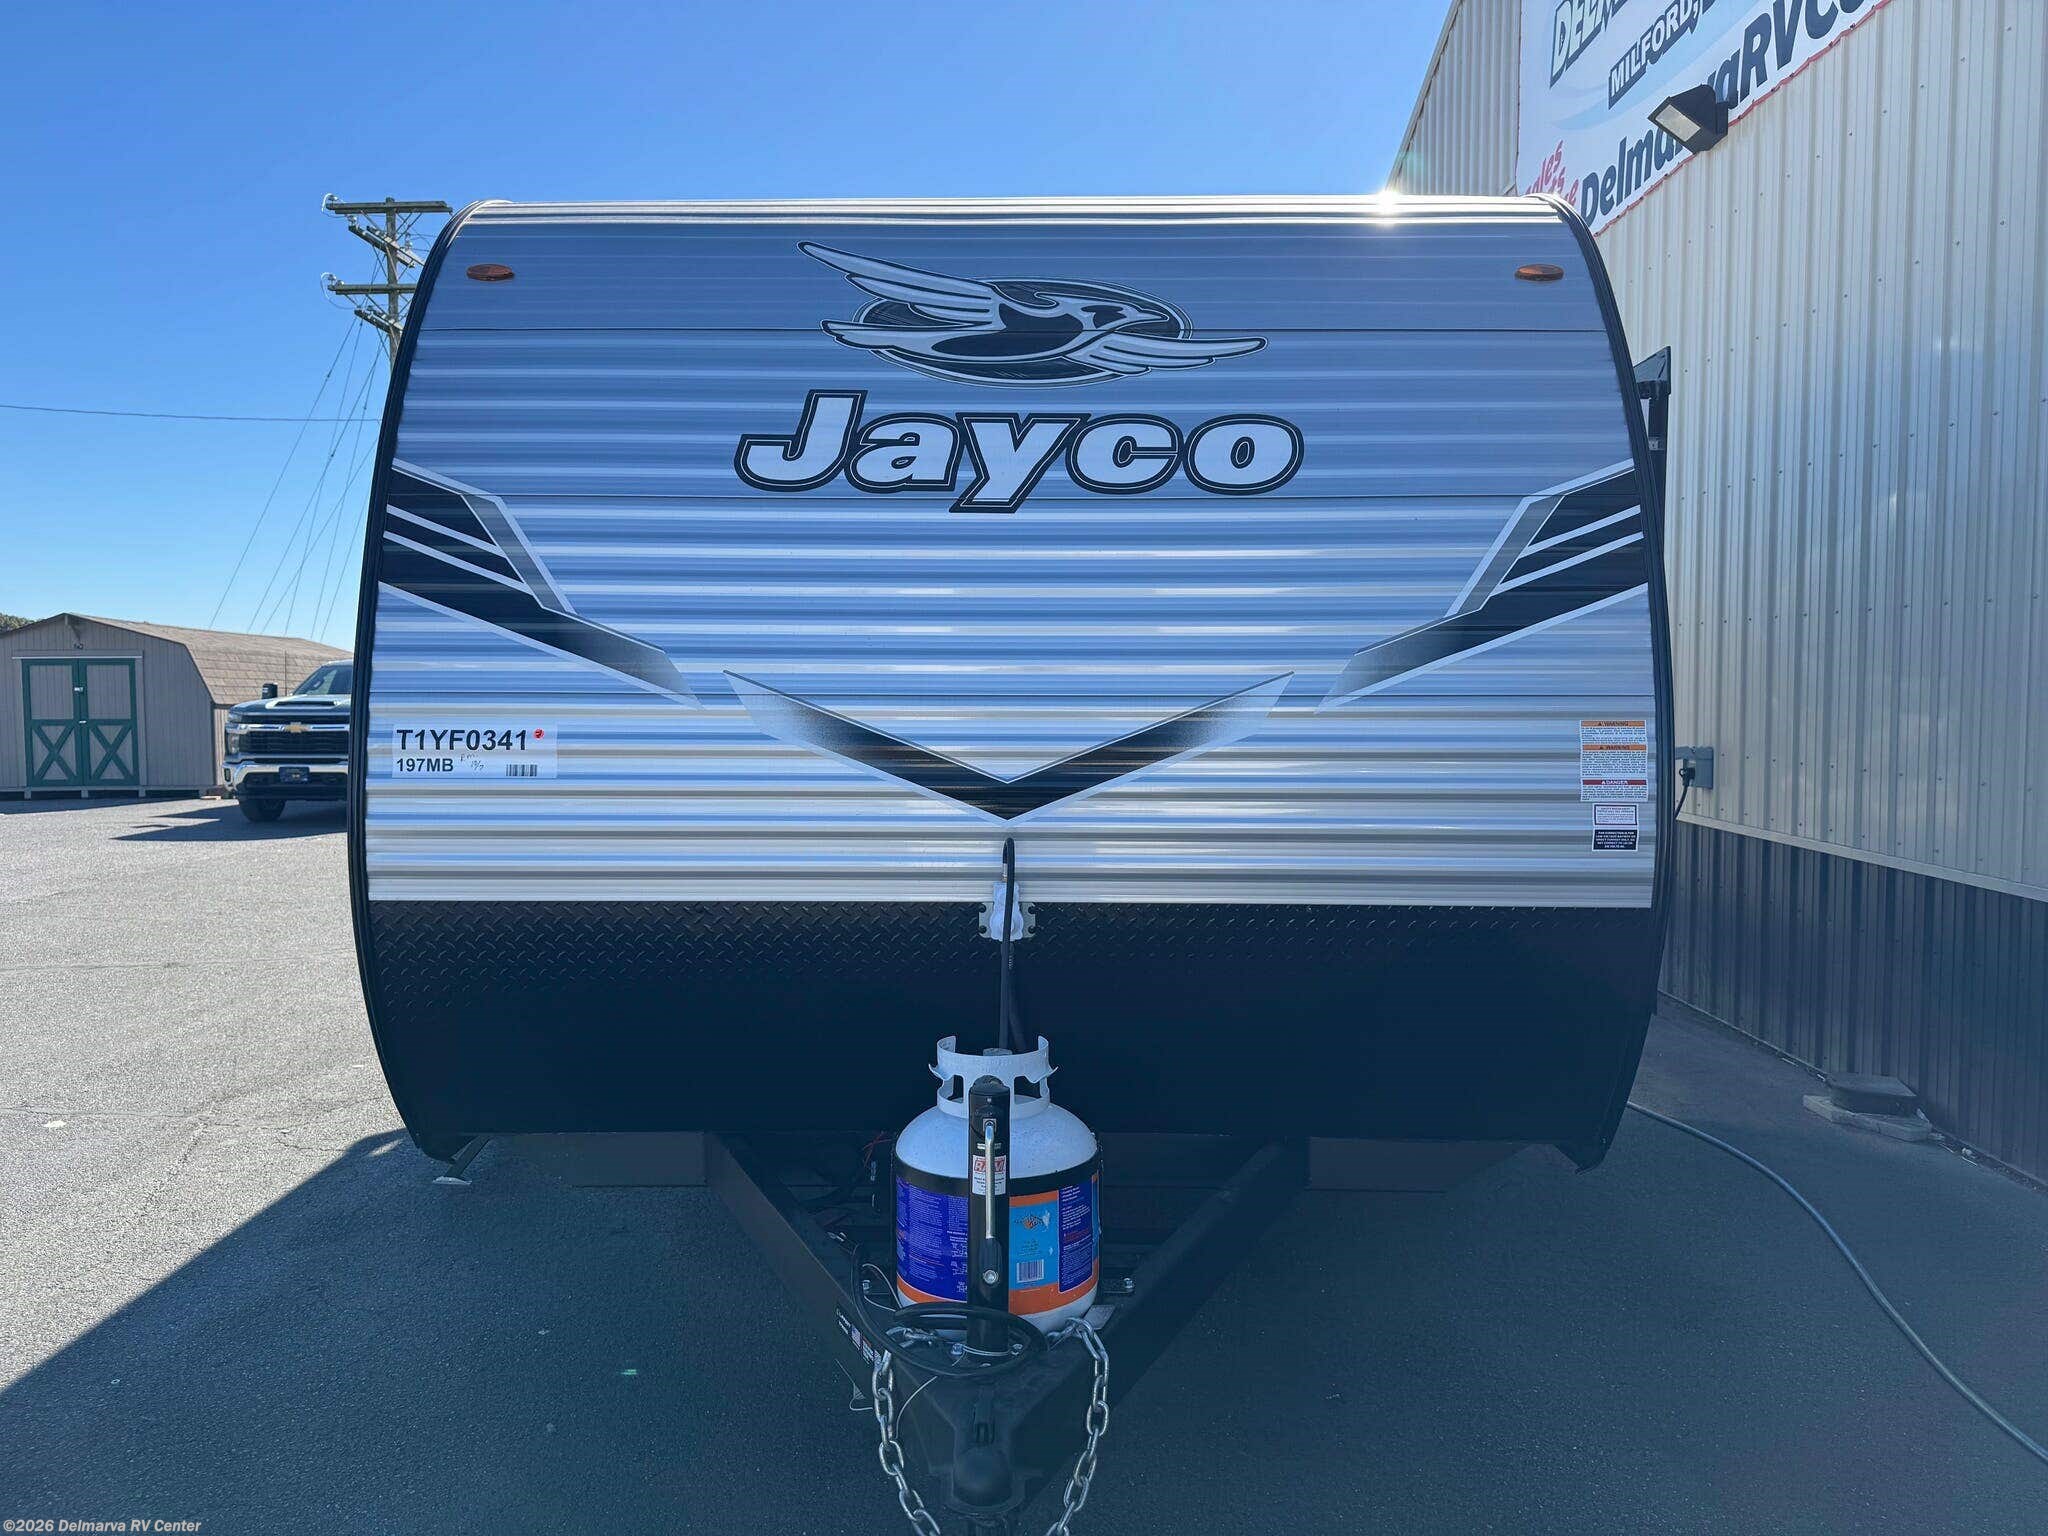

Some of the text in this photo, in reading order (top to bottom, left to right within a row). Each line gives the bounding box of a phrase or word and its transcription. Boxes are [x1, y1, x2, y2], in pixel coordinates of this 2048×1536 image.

[734, 389, 1304, 513] Jayco
[396, 729, 527, 751] T1YF0341
[396, 758, 454, 772] 197MB
